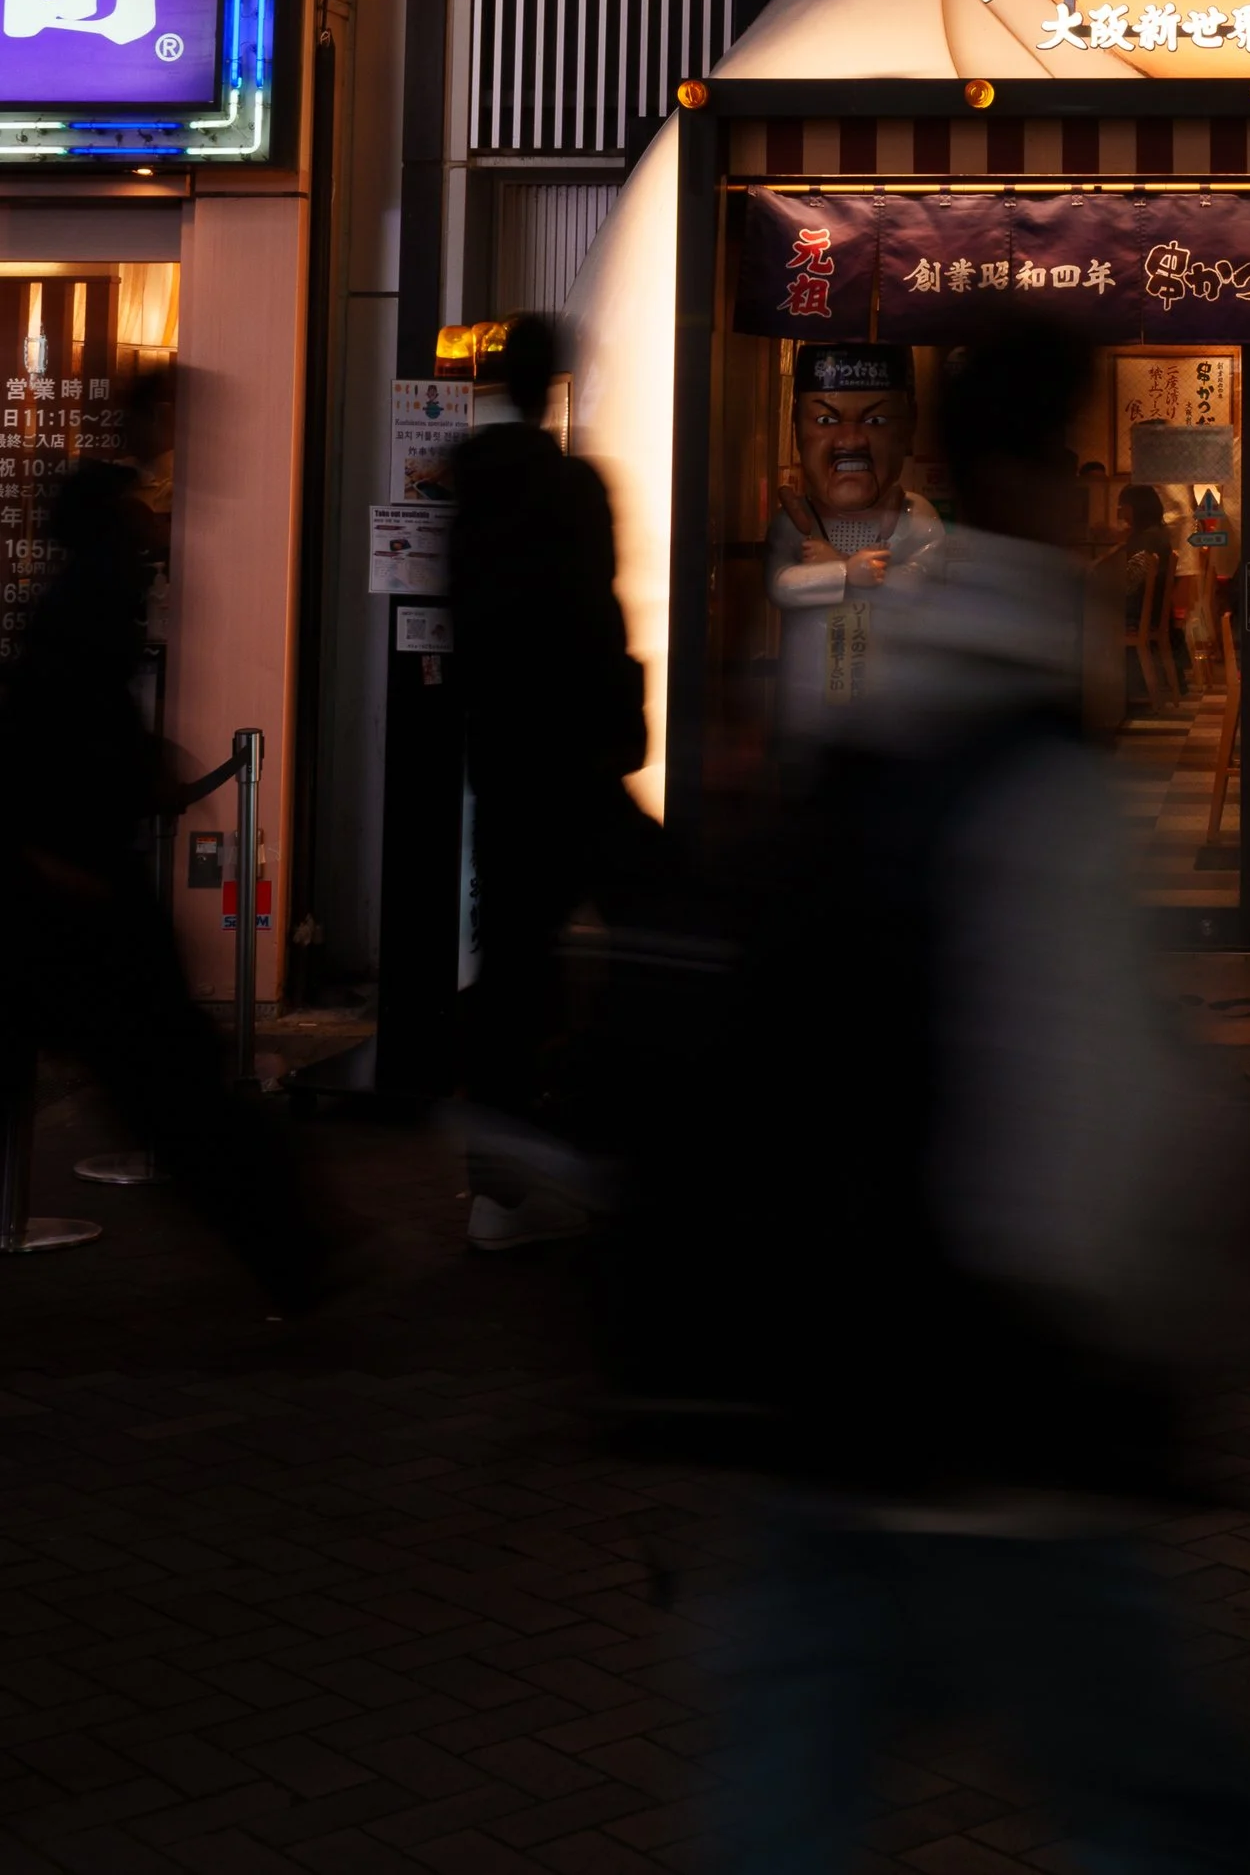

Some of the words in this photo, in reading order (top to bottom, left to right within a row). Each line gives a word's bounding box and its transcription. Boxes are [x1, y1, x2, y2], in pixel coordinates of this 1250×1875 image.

[777, 227, 835, 319] 元祖
[903, 258, 1117, 295] 創業昭和四年
[6, 377, 111, 401] 営業時間
